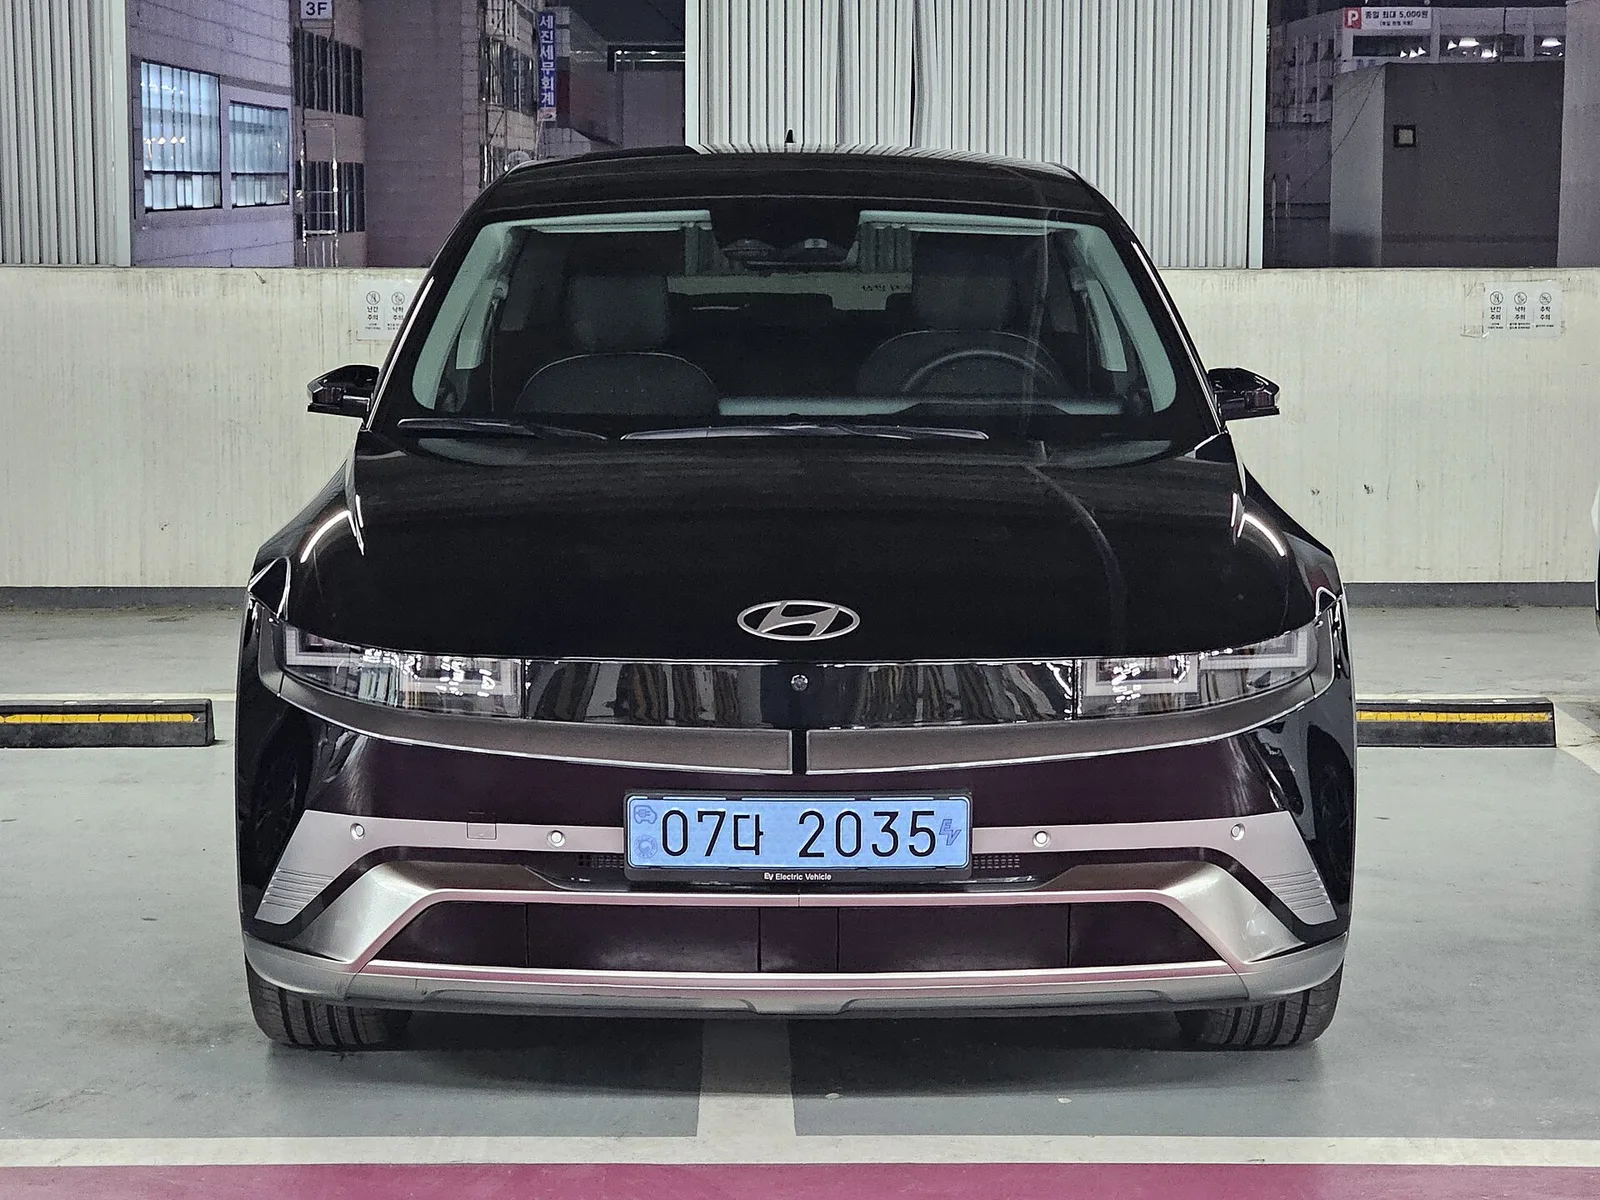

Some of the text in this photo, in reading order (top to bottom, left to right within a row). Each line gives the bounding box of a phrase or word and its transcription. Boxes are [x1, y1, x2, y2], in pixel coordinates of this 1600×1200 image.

[306, 2, 327, 16] 3F
[1382, 10, 1397, 19] 최대
[1347, 10, 1359, 26] P
[540, 15, 555, 106] 세진세무회계
[661, 809, 765, 857] 07다
[798, 810, 937, 858] 2035
[775, 872, 804, 881] Electric
[804, 872, 832, 881] Vehicle
